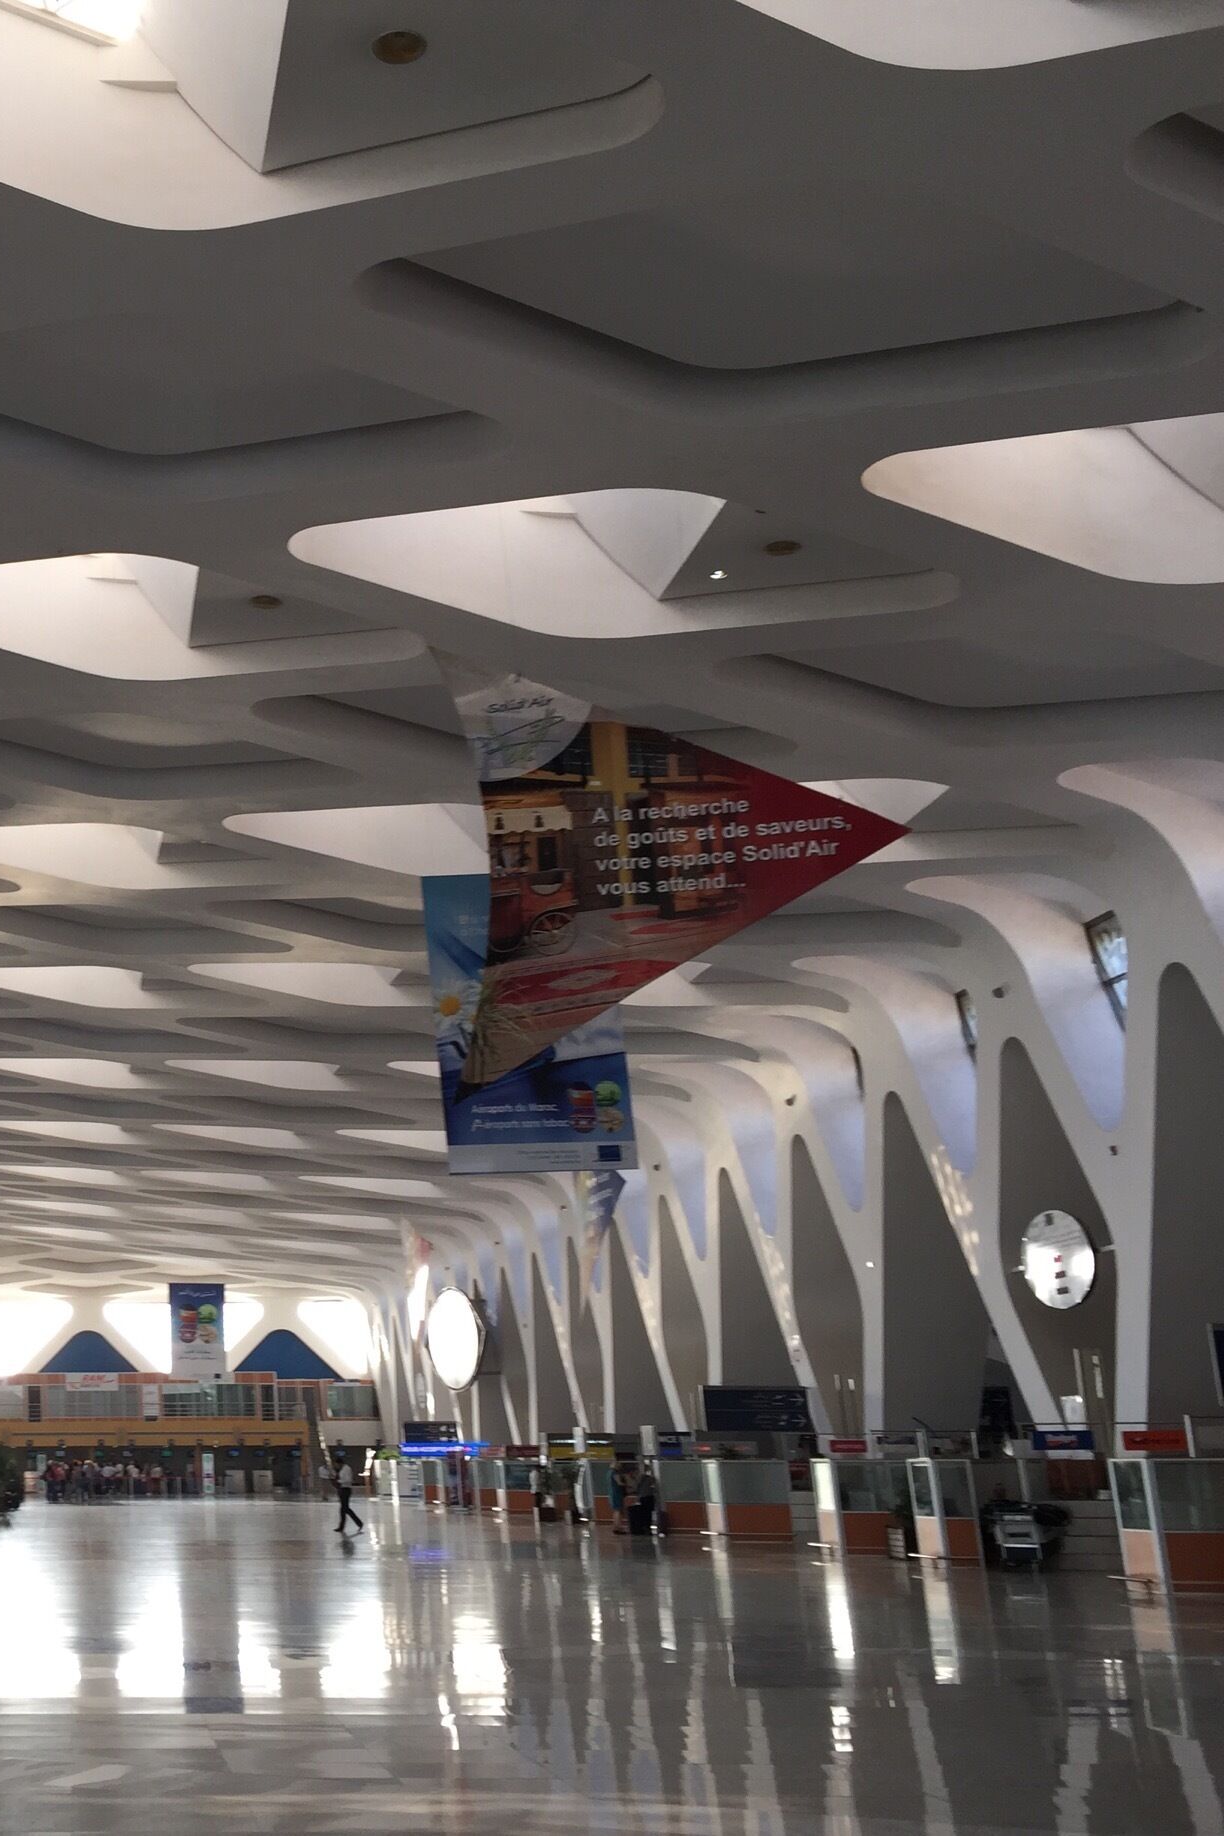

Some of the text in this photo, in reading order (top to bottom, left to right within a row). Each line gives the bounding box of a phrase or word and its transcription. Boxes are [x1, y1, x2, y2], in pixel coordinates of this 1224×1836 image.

[614, 806, 634, 822] la
[639, 799, 750, 820] recherche
[594, 814, 853, 850] de goûts et de saveurs,
[596, 839, 841, 872] votre espace Solid'Air
[596, 873, 747, 896] vous attend...
